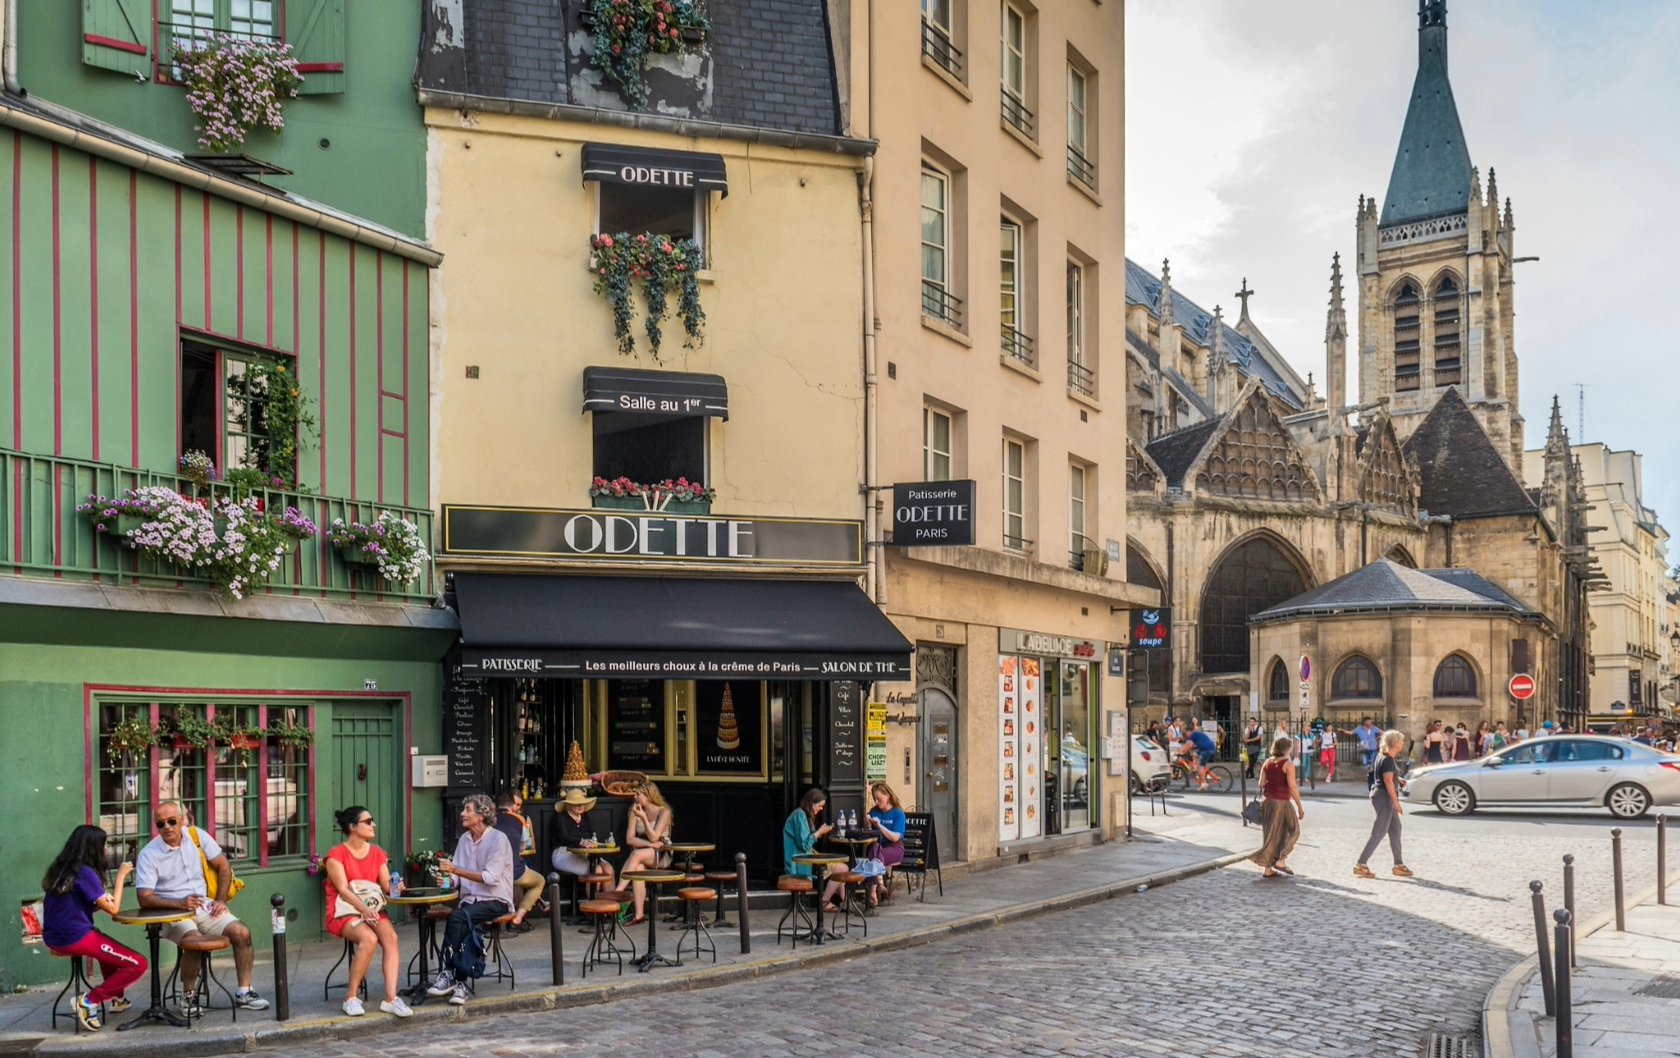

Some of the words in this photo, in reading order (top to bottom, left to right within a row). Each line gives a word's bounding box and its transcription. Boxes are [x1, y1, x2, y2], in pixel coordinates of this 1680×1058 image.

[621, 166, 694, 187] ODETTE
[620, 395, 656, 410] Salle
[660, 400, 678, 411] au
[683, 398, 701, 412] 1er
[908, 489, 957, 500] Patisserie
[896, 505, 968, 523] ODETTE
[564, 514, 752, 558] ODETTE
[916, 528, 948, 539] PARIS
[1139, 638, 1163, 648] soupe
[482, 658, 542, 673] PATISSERIE
[585, 660, 606, 671] Les
[609, 660, 661, 671] meilleurs
[663, 661, 696, 672] choux
[698, 661, 706, 672] à
[708, 661, 718, 672] la
[757, 662, 770, 672] de
[773, 662, 800, 672] Paris
[821, 661, 857, 673] SALON
[859, 662, 873, 673] DE
[875, 662, 896, 673] THE
[101, 943, 139, 965] Champion
